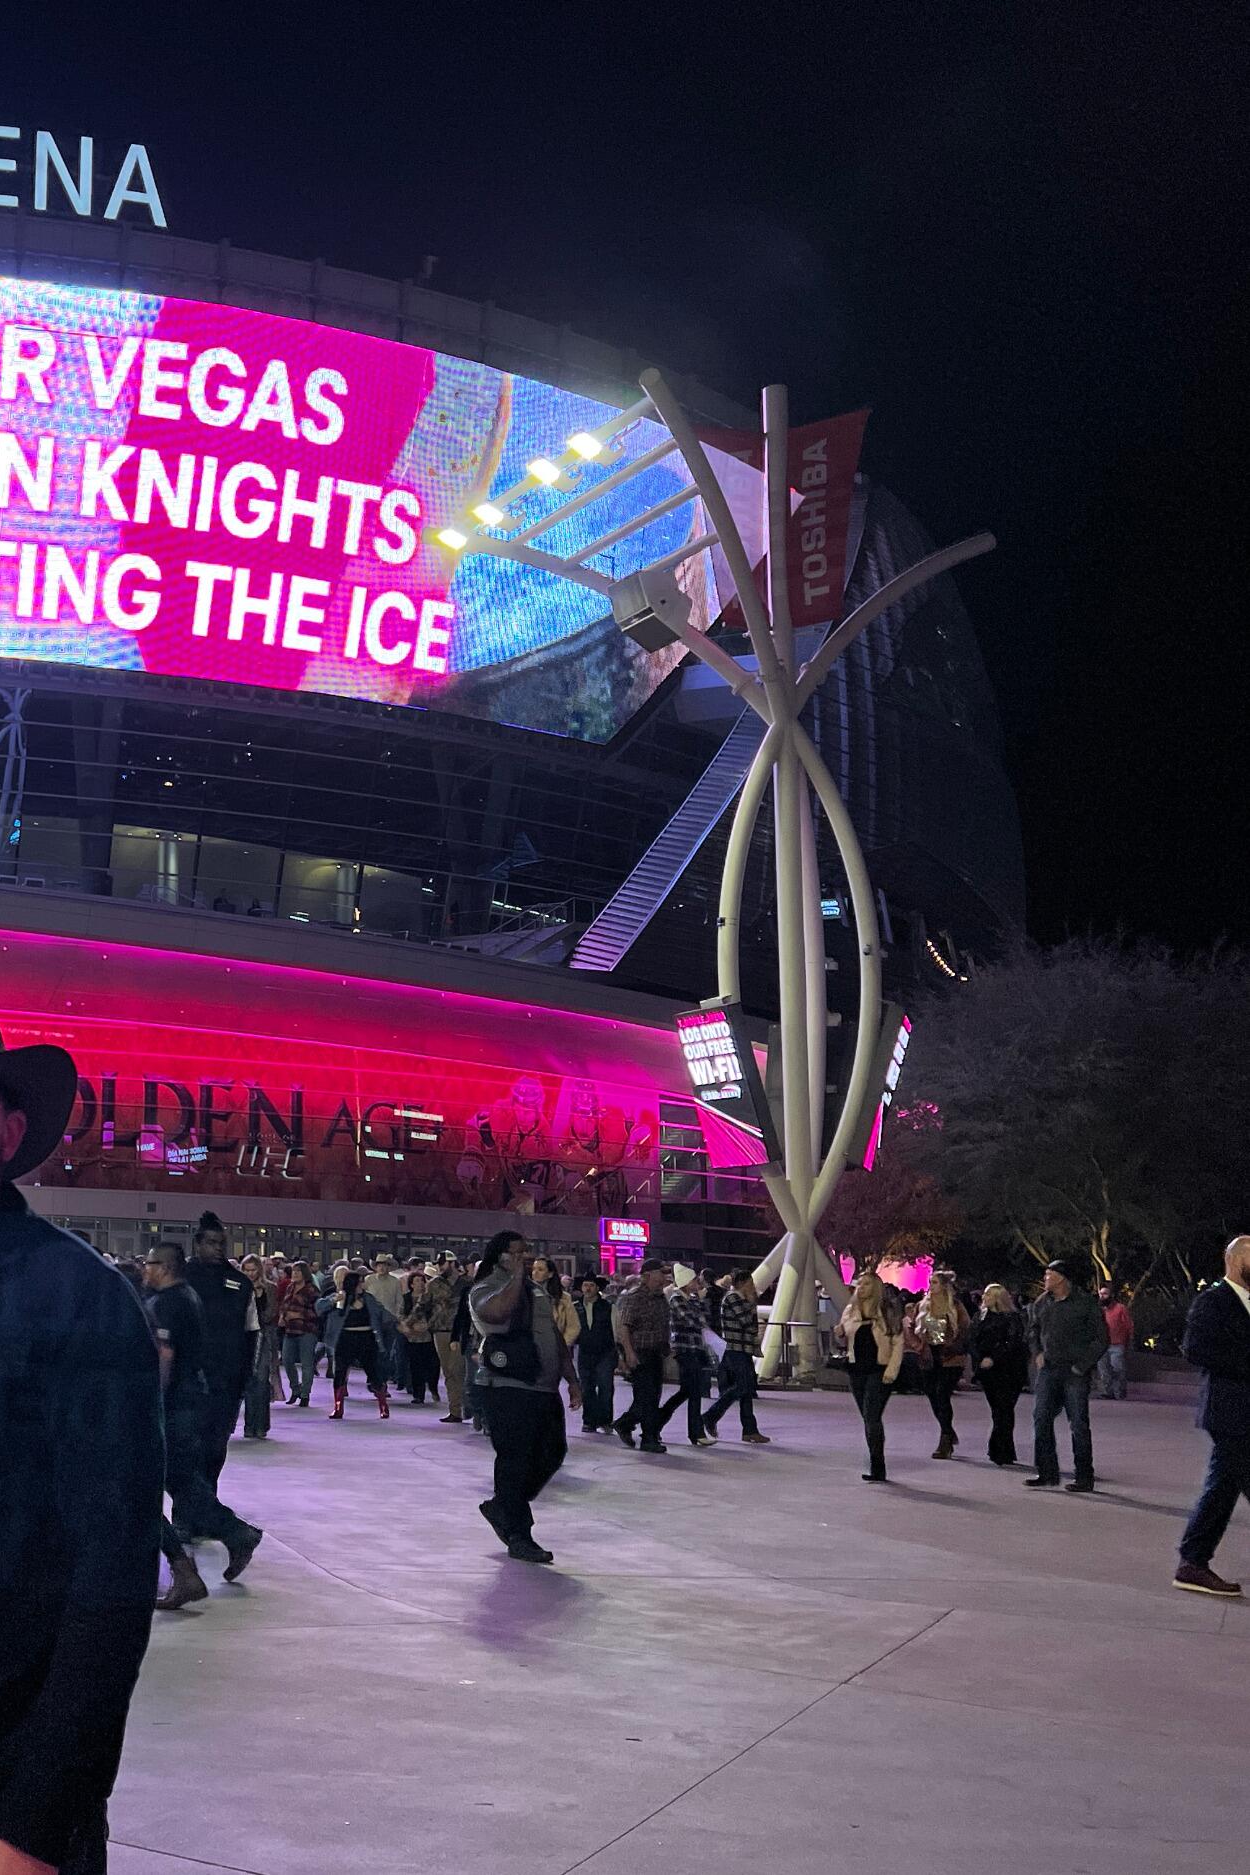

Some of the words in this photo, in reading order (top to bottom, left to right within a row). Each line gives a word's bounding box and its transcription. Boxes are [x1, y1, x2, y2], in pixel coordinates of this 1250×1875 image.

[82, 335, 349, 446] VEGAS
[79, 439, 423, 566] KNIGHTS
[801, 437, 830, 606] TOSHIBA
[184, 560, 332, 654] THE
[343, 584, 456, 675] ICE
[678, 1026, 702, 1045] LOG
[700, 1021, 731, 1041] ONTO
[683, 1041, 709, 1060] OUR
[706, 1037, 736, 1057] FREE
[687, 1054, 743, 1086] WI-FI!
